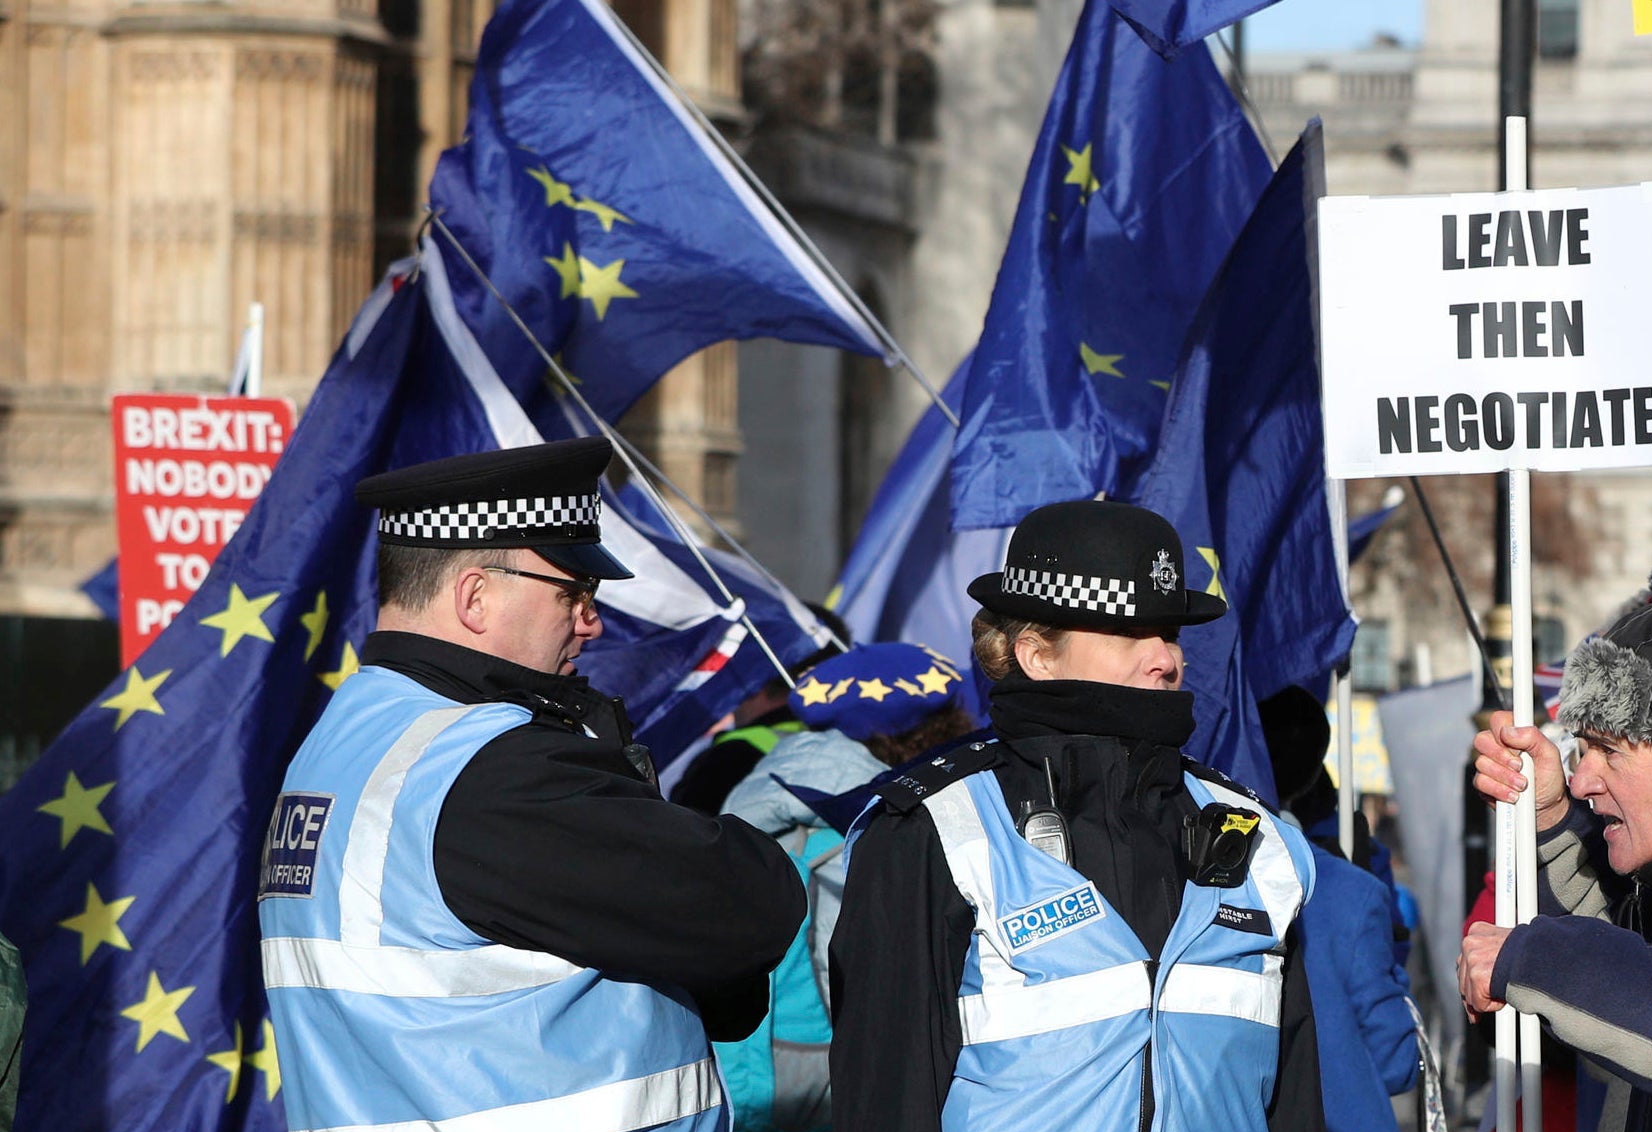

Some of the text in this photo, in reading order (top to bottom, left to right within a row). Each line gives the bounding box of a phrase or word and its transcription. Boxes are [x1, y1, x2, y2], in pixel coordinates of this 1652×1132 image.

[1442, 208, 1591, 270] LEAVE
[1449, 300, 1585, 359] THEN
[123, 406, 283, 453] BREXIT:
[126, 457, 273, 500] NOBOD
[155, 552, 211, 590] TO
[1006, 888, 1095, 938] POLICE
[1012, 905, 1098, 947] LIAISON OFFICER
